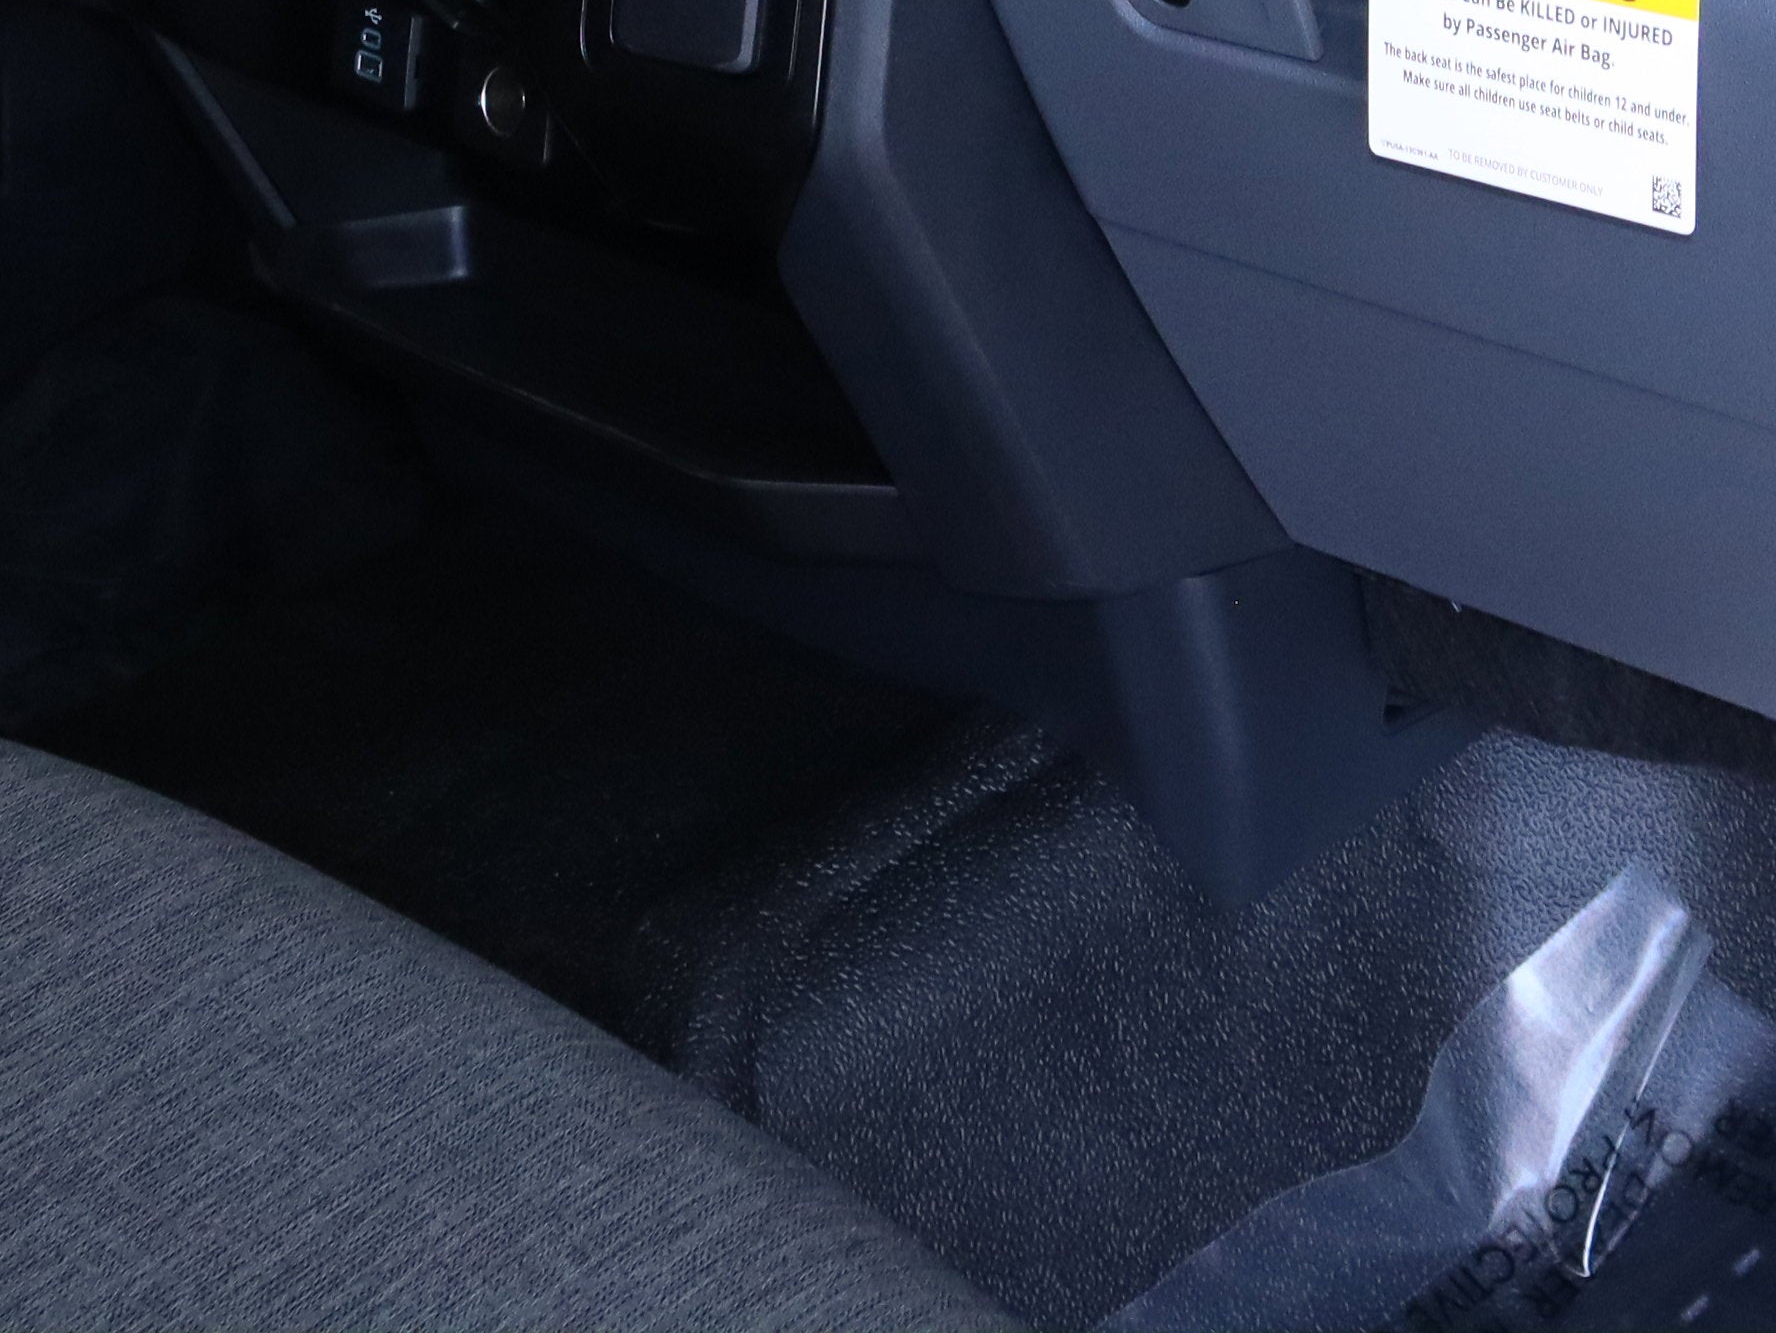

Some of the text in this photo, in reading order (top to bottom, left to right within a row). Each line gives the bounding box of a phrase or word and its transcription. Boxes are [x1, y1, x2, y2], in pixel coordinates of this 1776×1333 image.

[1443, 12, 1614, 70] by Passenger Air Bag.
[1580, 15, 1597, 30] or
[1603, 16, 1673, 46] INJURED
[1384, 41, 1690, 126] The back seat is the safest place for children 12 and under.
[1404, 69, 1668, 145] Make sure all children use seat belts or child seats.
[1448, 148, 1461, 161] TO
[1462, 153, 1473, 164] BE
[1474, 155, 1515, 176] REMOVED
[1517, 165, 1529, 178] BY
[1530, 169, 1578, 190] CUSTOMER
[1580, 181, 1604, 198] ONLY
